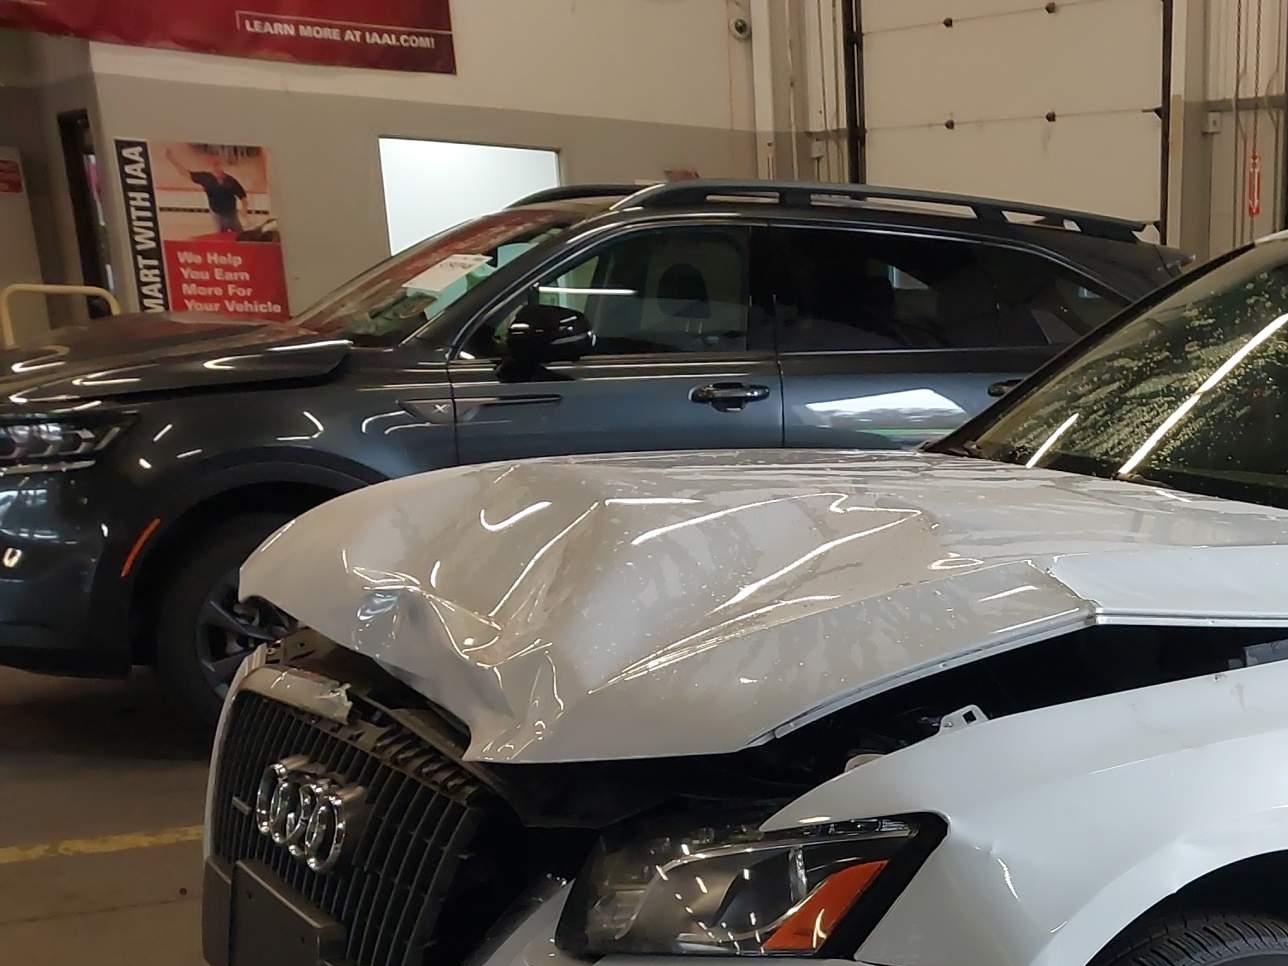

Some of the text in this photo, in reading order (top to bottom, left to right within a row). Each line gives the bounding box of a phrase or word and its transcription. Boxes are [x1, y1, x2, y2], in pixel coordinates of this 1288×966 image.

[245, 19, 435, 49] LEARN MORE AT IAAI.COM!
[122, 145, 165, 313] MART WITH IAA
[177, 252, 242, 266] We Help
[180, 268, 249, 281] You Earn
[182, 283, 253, 297] More For
[184, 299, 282, 313] Your Vehicle
